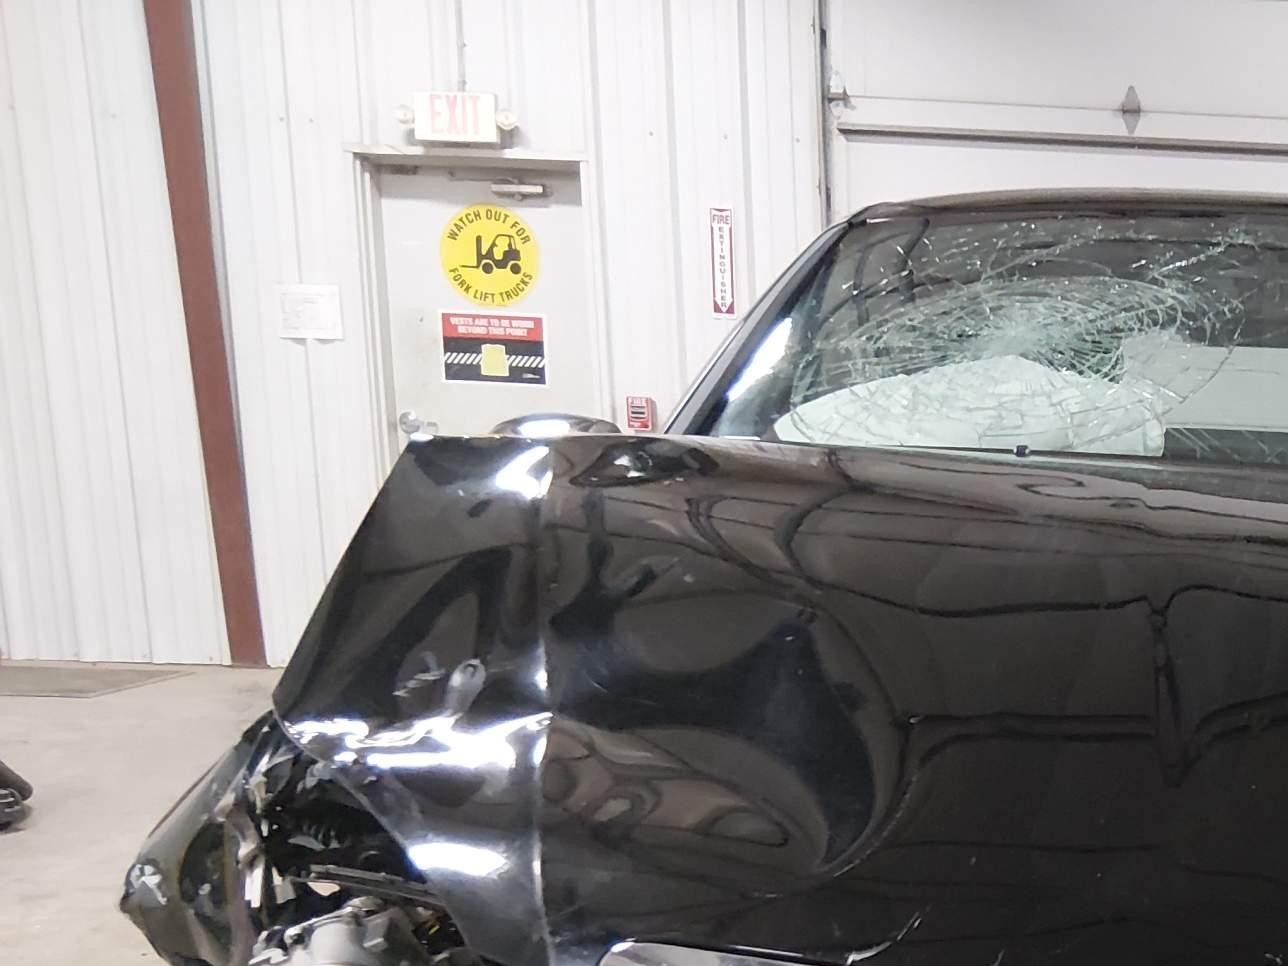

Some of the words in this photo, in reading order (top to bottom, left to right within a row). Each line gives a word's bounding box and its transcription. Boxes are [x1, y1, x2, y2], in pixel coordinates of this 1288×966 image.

[430, 94, 480, 135] EXIT
[447, 209, 482, 241] WATCH
[485, 208, 510, 224] OUT
[509, 220, 531, 245] FOR
[712, 214, 730, 225] FIRE
[448, 267, 473, 295] FORK
[472, 289, 496, 304] LIFT
[499, 272, 534, 303] TRUCKS
